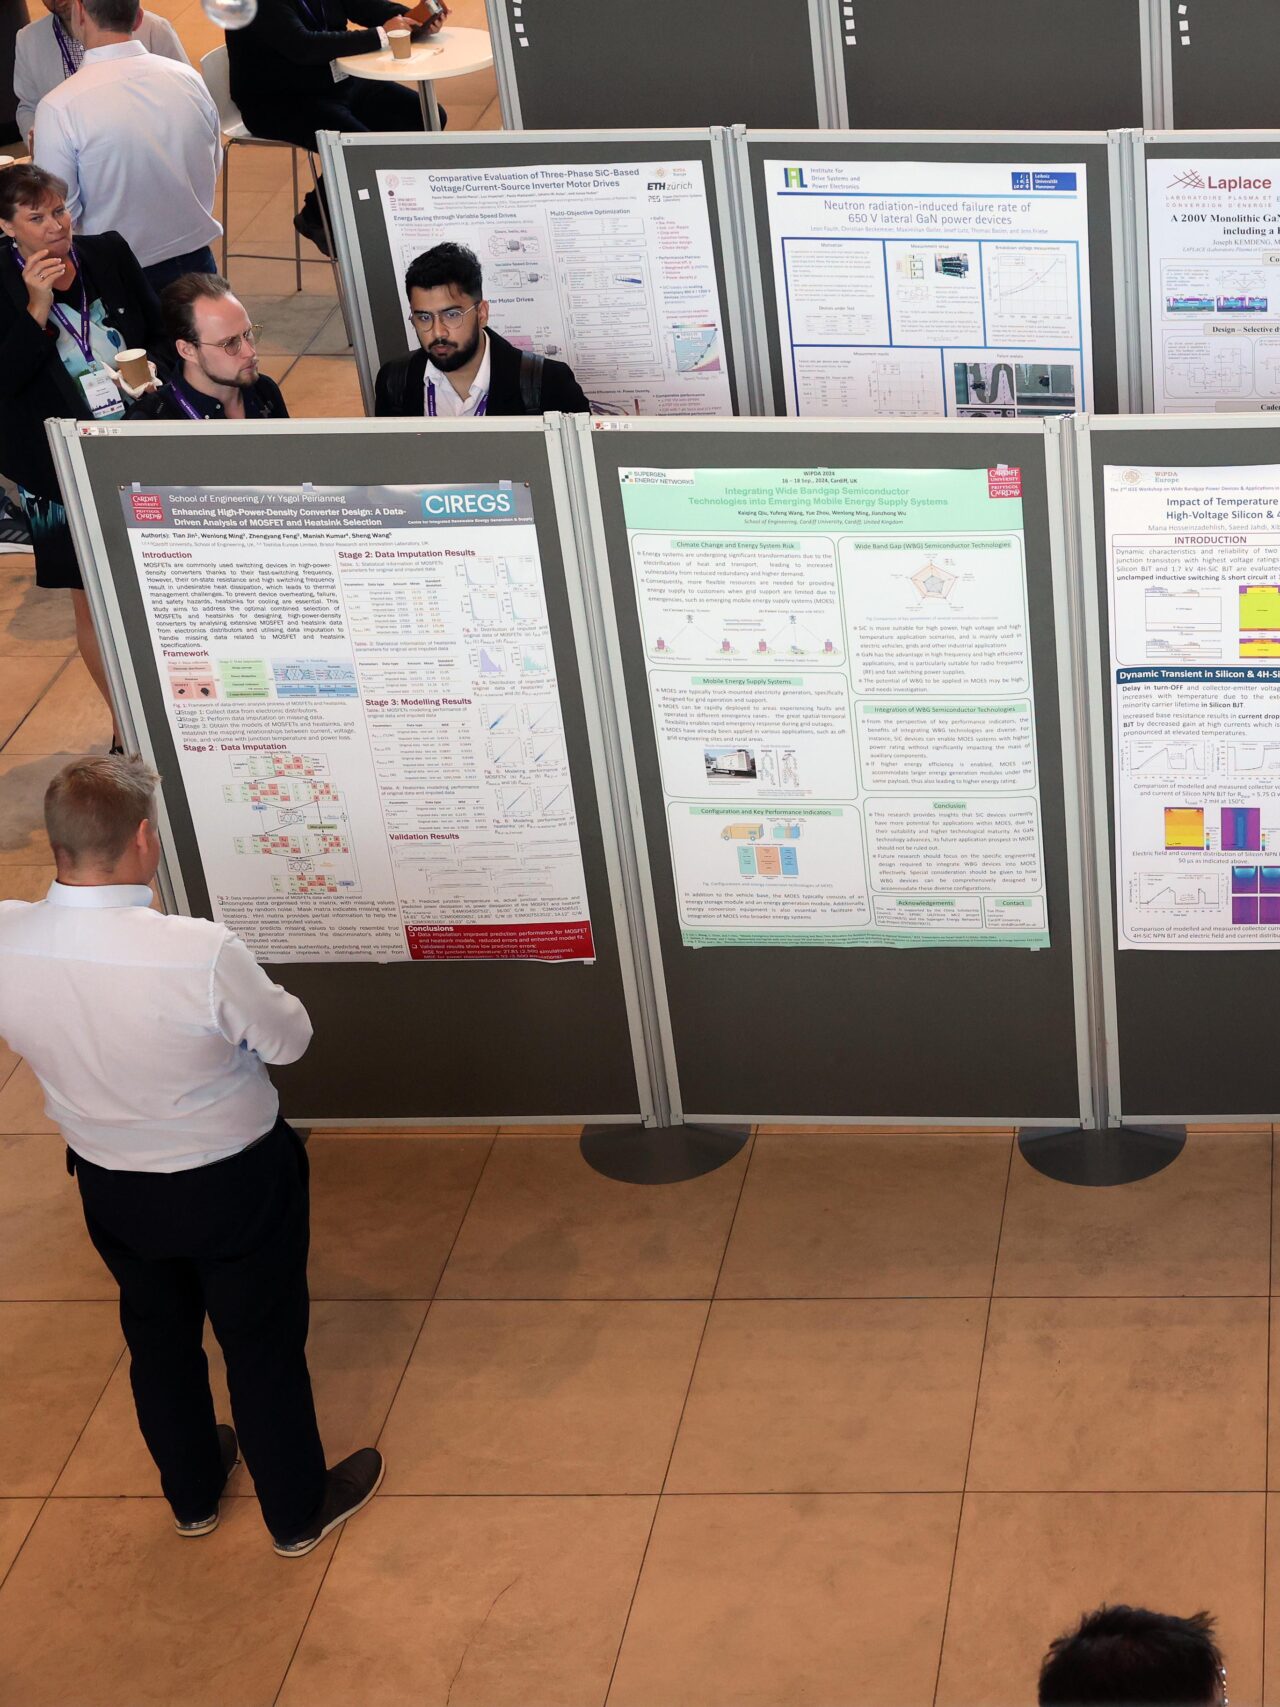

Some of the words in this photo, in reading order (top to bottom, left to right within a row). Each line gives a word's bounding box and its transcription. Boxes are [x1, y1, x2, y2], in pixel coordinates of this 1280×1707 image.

[428, 174, 482, 183] Comparative
[595, 168, 639, 177] SiC-Based
[430, 182, 530, 192] Voltage/Current-Source
[1208, 176, 1271, 192] Laplace
[824, 200, 864, 210] Neutron
[869, 201, 957, 211] radiation-induced
[962, 201, 993, 211] failure
[998, 204, 1017, 212] rate
[1021, 202, 1031, 212] of
[848, 213, 867, 222] 650
[870, 213, 877, 222] V
[881, 214, 912, 223] lateral
[916, 213, 937, 223] GaN
[941, 216, 971, 225] power
[975, 214, 1011, 224] devices
[1223, 227, 1266, 235] including
[725, 487, 773, 497] Integrating
[800, 487, 839, 497] Bandgap
[169, 493, 198, 502] School
[199, 493, 207, 502] of
[210, 494, 259, 505] Engineering
[260, 493, 264, 504] /
[266, 493, 275, 502] Yr
[277, 492, 300, 505] Ysgol
[302, 492, 345, 504] Peirianneg
[688, 497, 746, 506] Technologies
[768, 497, 810, 507] Emerging
[844, 498, 875, 507] Energy
[878, 498, 909, 507] Supply
[910, 498, 948, 507] Systems
[1167, 498, 1200, 507] Impact
[1203, 497, 1213, 505] of
[1216, 497, 1278, 506] Temperature
[425, 494, 509, 514] CIREGS
[171, 508, 216, 516] Enhancing
[217, 508, 297, 517] High-Power-Density
[1166, 511, 1228, 520] High-Voltage
[203, 518, 238, 528] Analysis
[1175, 536, 1246, 546] INTRODUCTION
